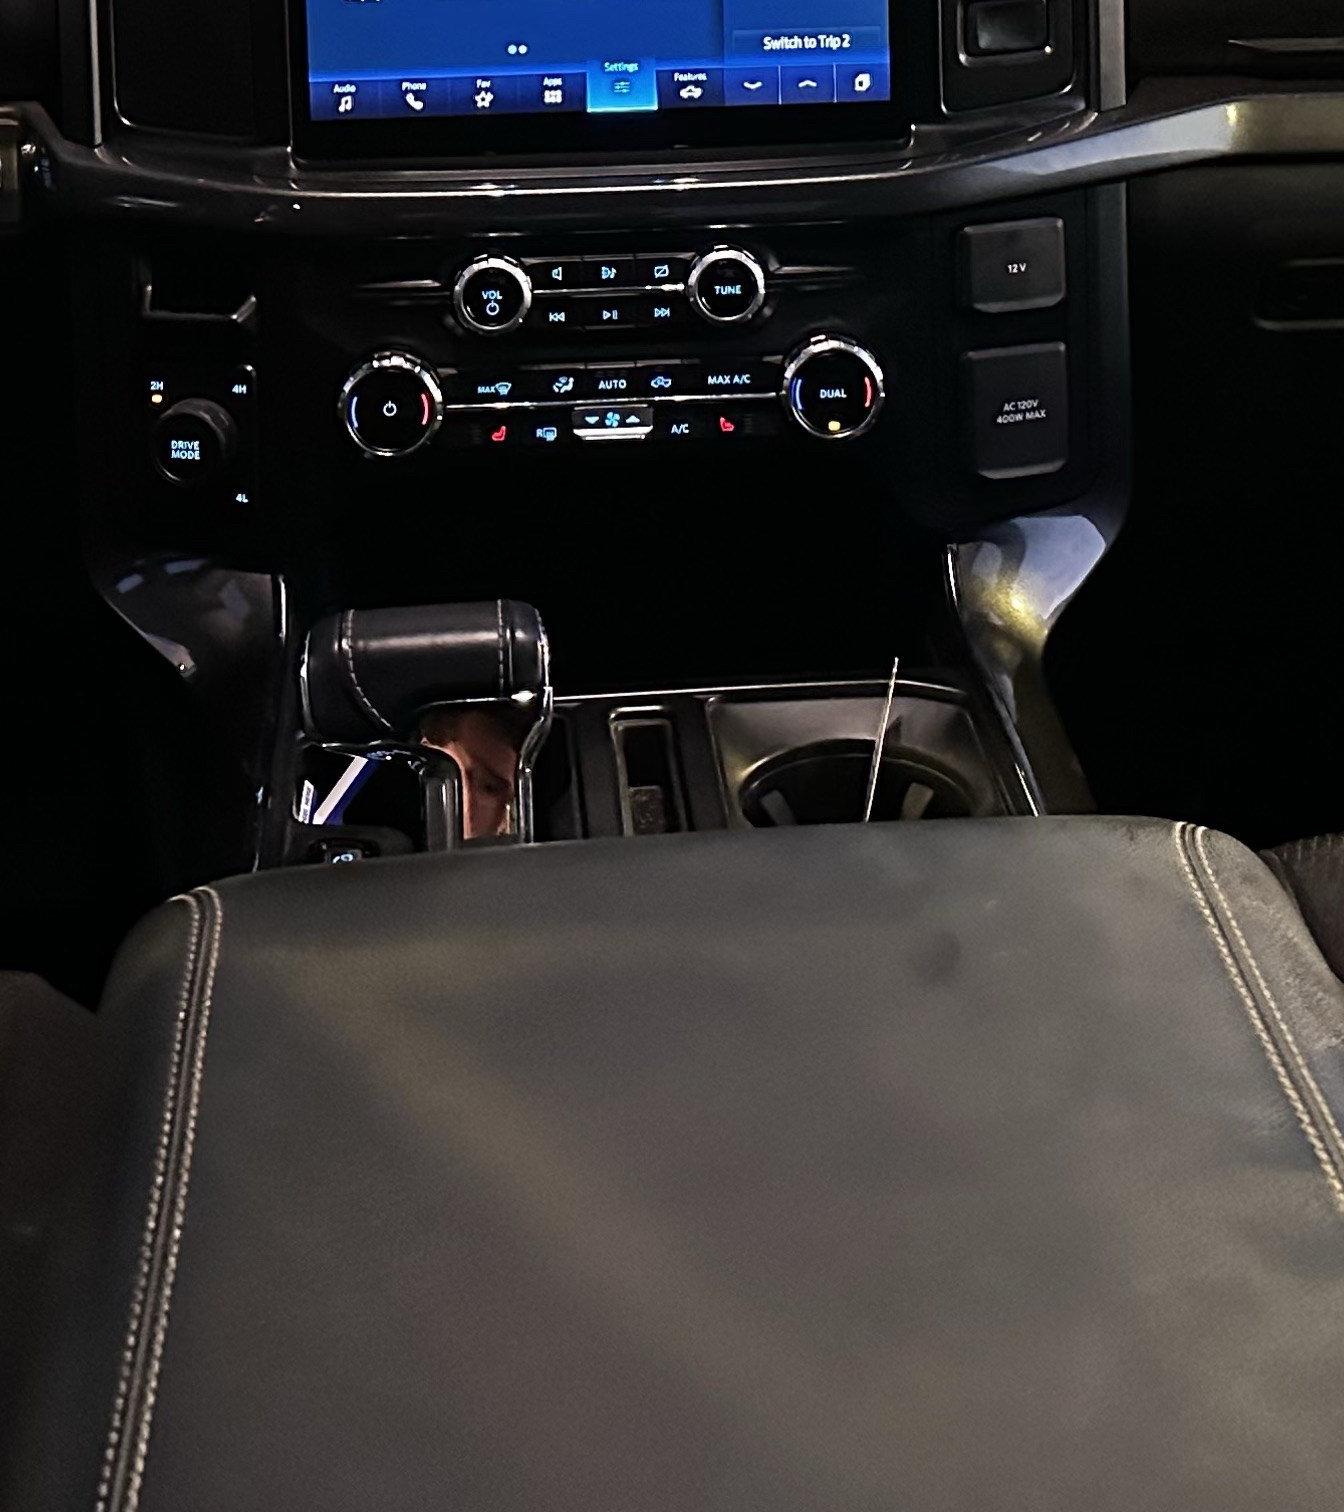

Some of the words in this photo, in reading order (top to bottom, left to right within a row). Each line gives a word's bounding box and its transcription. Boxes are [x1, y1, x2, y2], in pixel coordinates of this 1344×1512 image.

[763, 36, 803, 50] Switch
[805, 37, 816, 49] to
[818, 35, 841, 50] Trip
[843, 34, 850, 47] 2
[604, 62, 638, 72] Settings
[543, 77, 562, 87] Apps
[674, 72, 707, 82] Features
[333, 84, 356, 93] Audio
[402, 81, 426, 91] Phone
[476, 80, 491, 88] Fav
[1007, 263, 1018, 274] 12
[1019, 263, 1027, 273] V
[714, 284, 742, 296] TUNE
[481, 290, 503, 301] VOL
[598, 378, 627, 390] AUTO
[707, 373, 730, 385] MAX
[731, 373, 751, 384] A/C
[150, 381, 164, 391] 2H
[232, 384, 247, 395] 4H
[477, 385, 496, 394] MAX
[819, 388, 847, 399] DUAL
[1003, 401, 1016, 412] AC
[1017, 399, 1039, 411] 120V
[996, 411, 1024, 424] 400W
[1025, 409, 1046, 421] MAX
[670, 423, 690, 436] A/C
[171, 440, 199, 450] DRIVE
[171, 449, 200, 459] MODE
[235, 493, 249, 503] 4L
